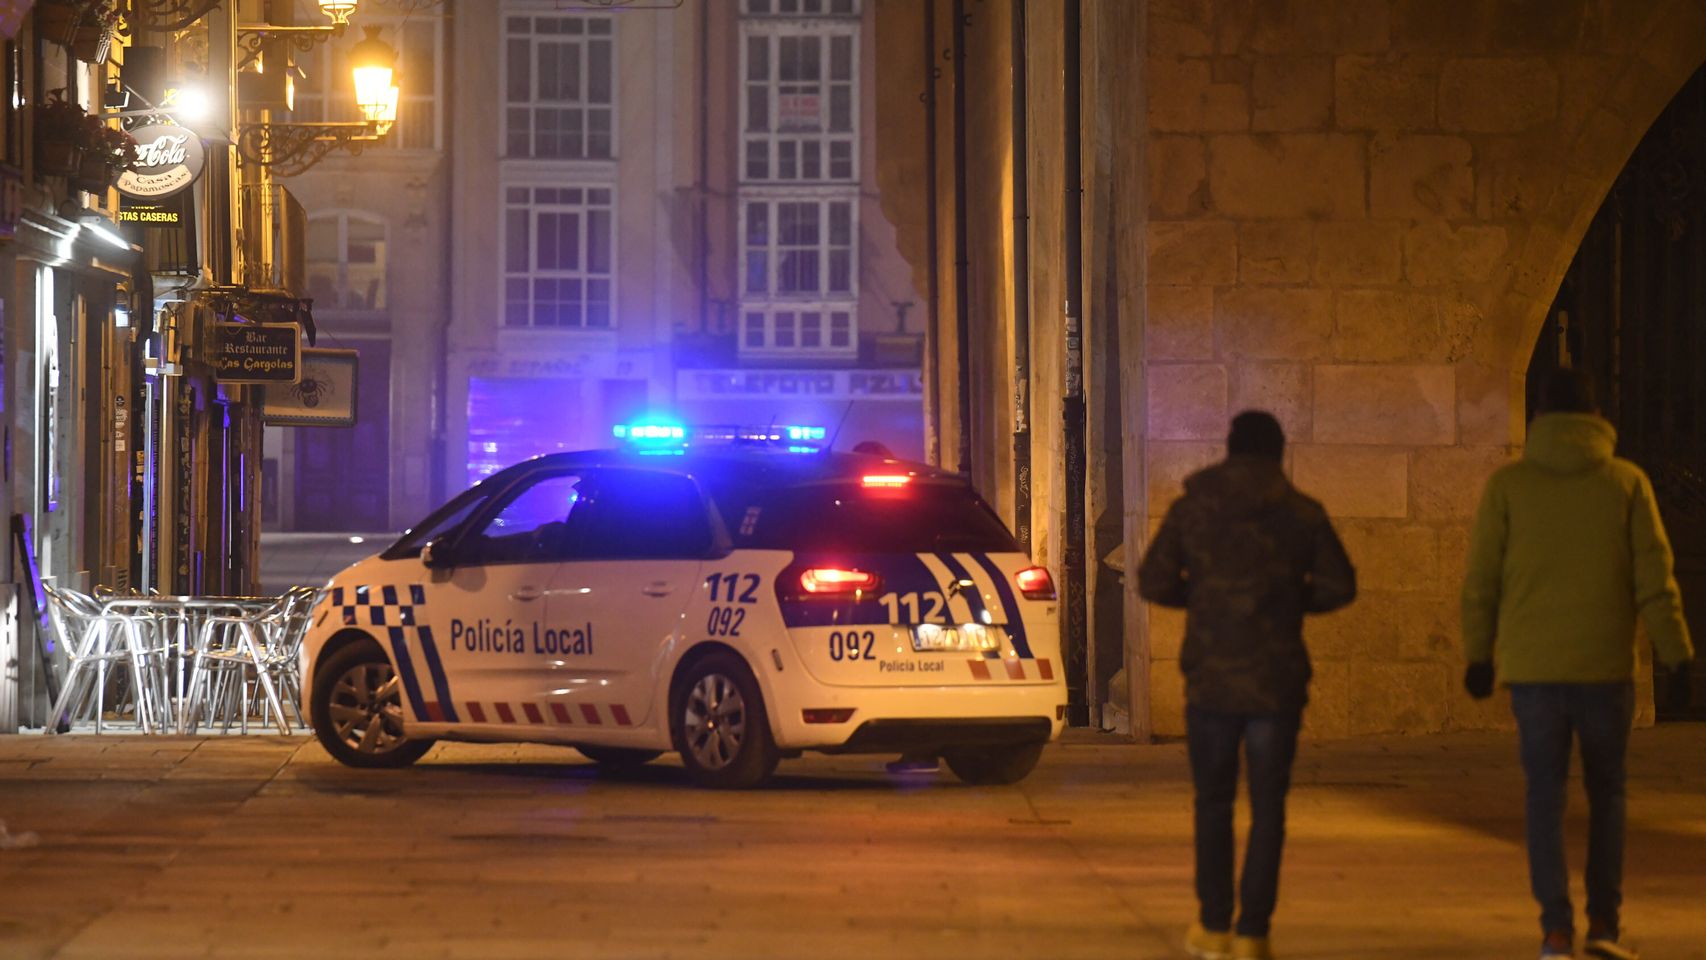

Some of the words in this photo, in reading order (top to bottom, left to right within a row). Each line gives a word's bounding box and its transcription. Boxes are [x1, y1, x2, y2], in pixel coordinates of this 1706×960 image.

[136, 176, 171, 186] Casa
[140, 212, 178, 222] CASERAS
[246, 331, 267, 342] Bar
[224, 342, 288, 354] Restaurante
[706, 573, 760, 603] 112
[878, 591, 947, 624] 112
[707, 606, 746, 637] 092
[451, 618, 525, 653] Policía
[533, 621, 593, 655] Local
[829, 630, 876, 661] 092
[918, 660, 945, 672] Local
